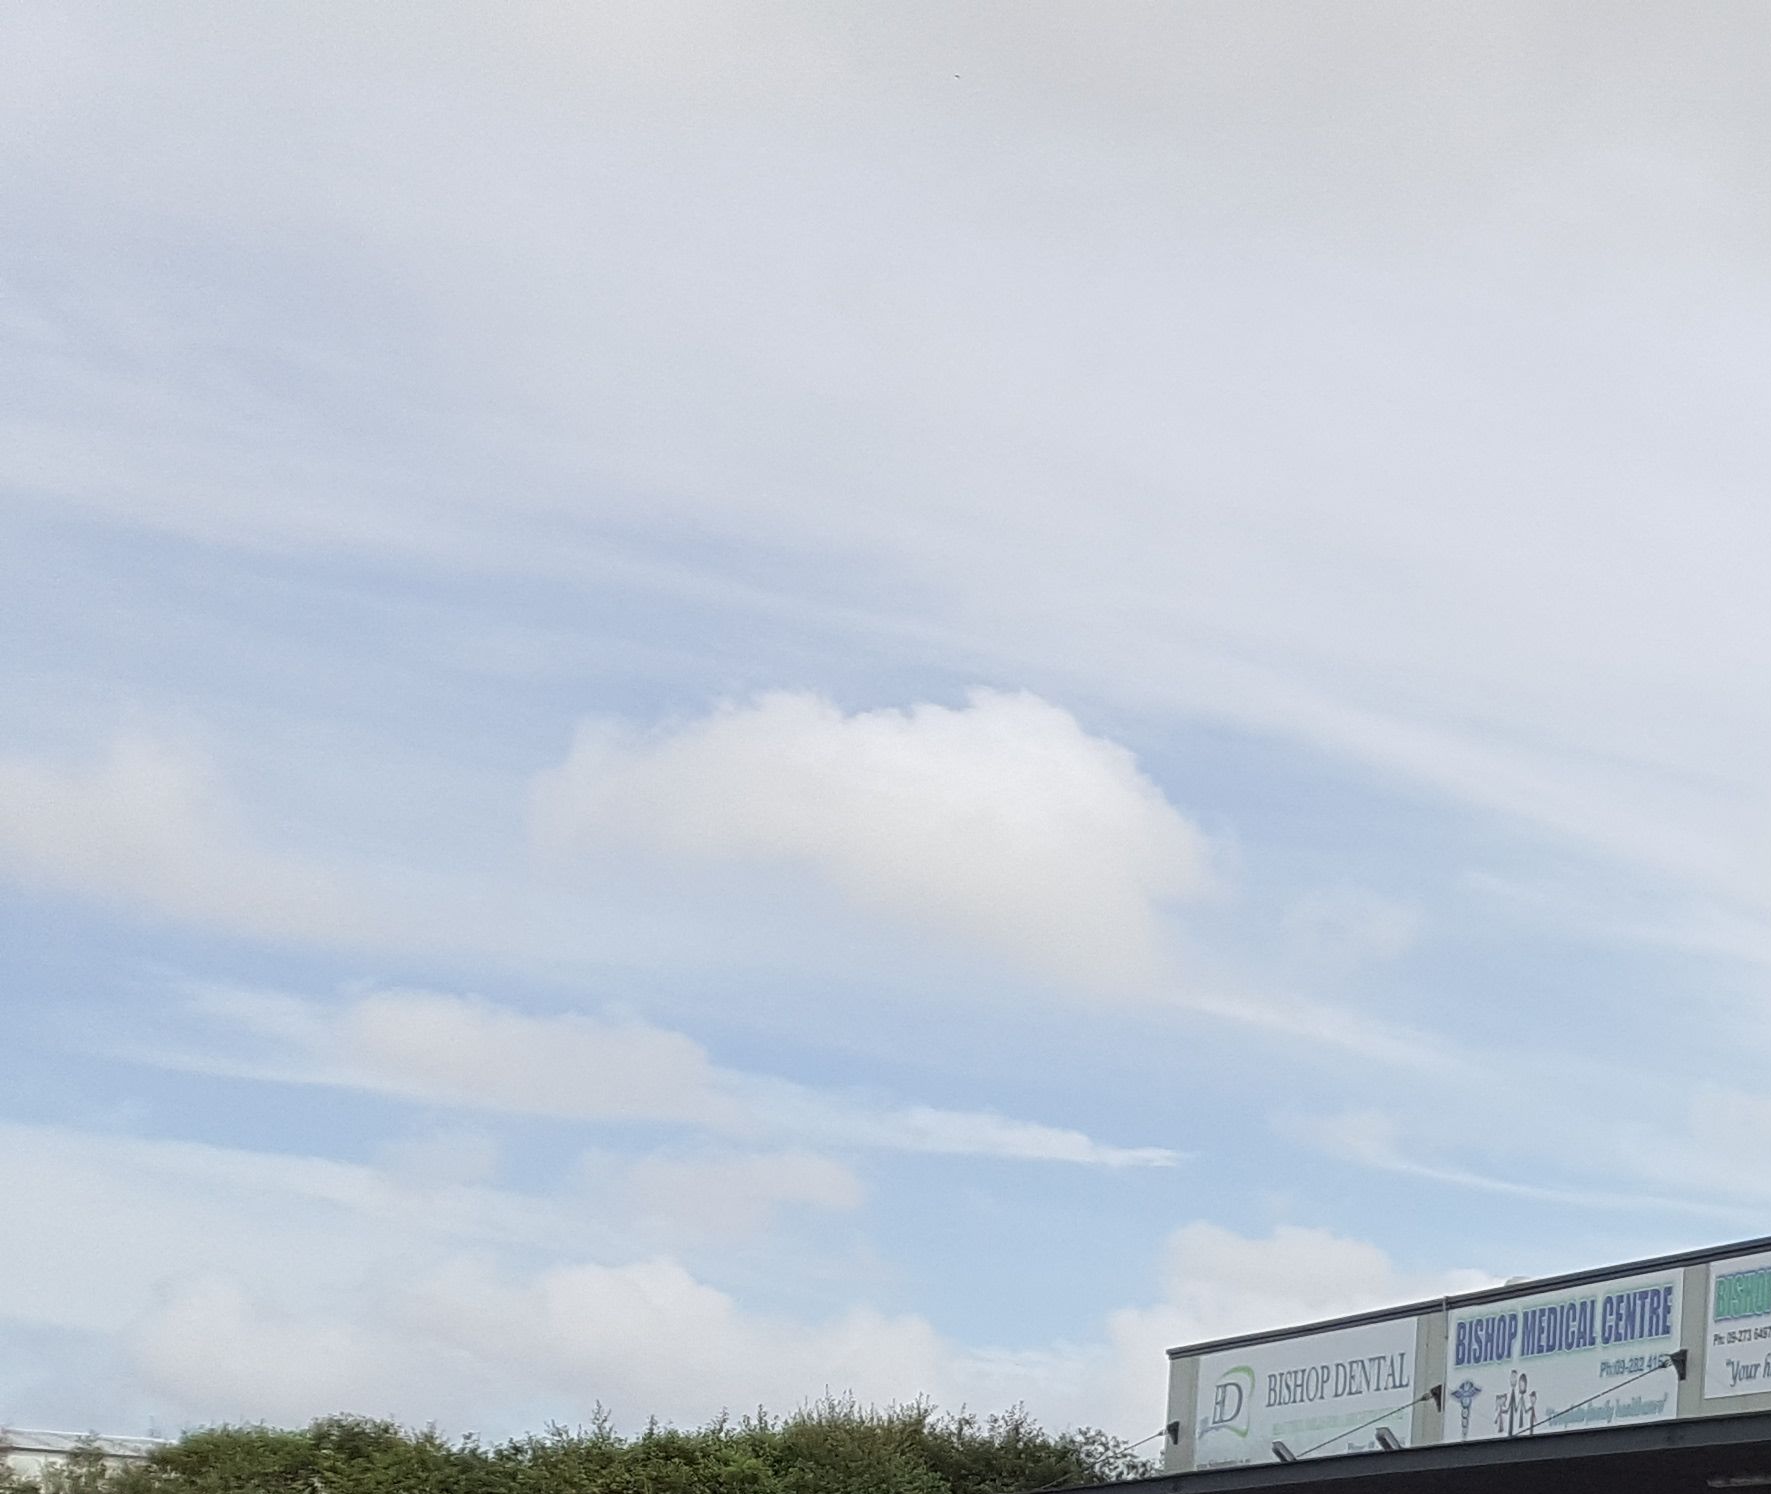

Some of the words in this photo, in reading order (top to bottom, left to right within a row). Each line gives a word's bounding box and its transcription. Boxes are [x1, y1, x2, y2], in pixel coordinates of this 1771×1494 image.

[1455, 1311, 1517, 1366] BISHOP
[1520, 1299, 1597, 1356] MEDICAL
[1601, 1285, 1673, 1345] CENTRE
[1266, 1364, 1330, 1408] BISHOP
[1334, 1353, 1409, 1397] DENTAL
